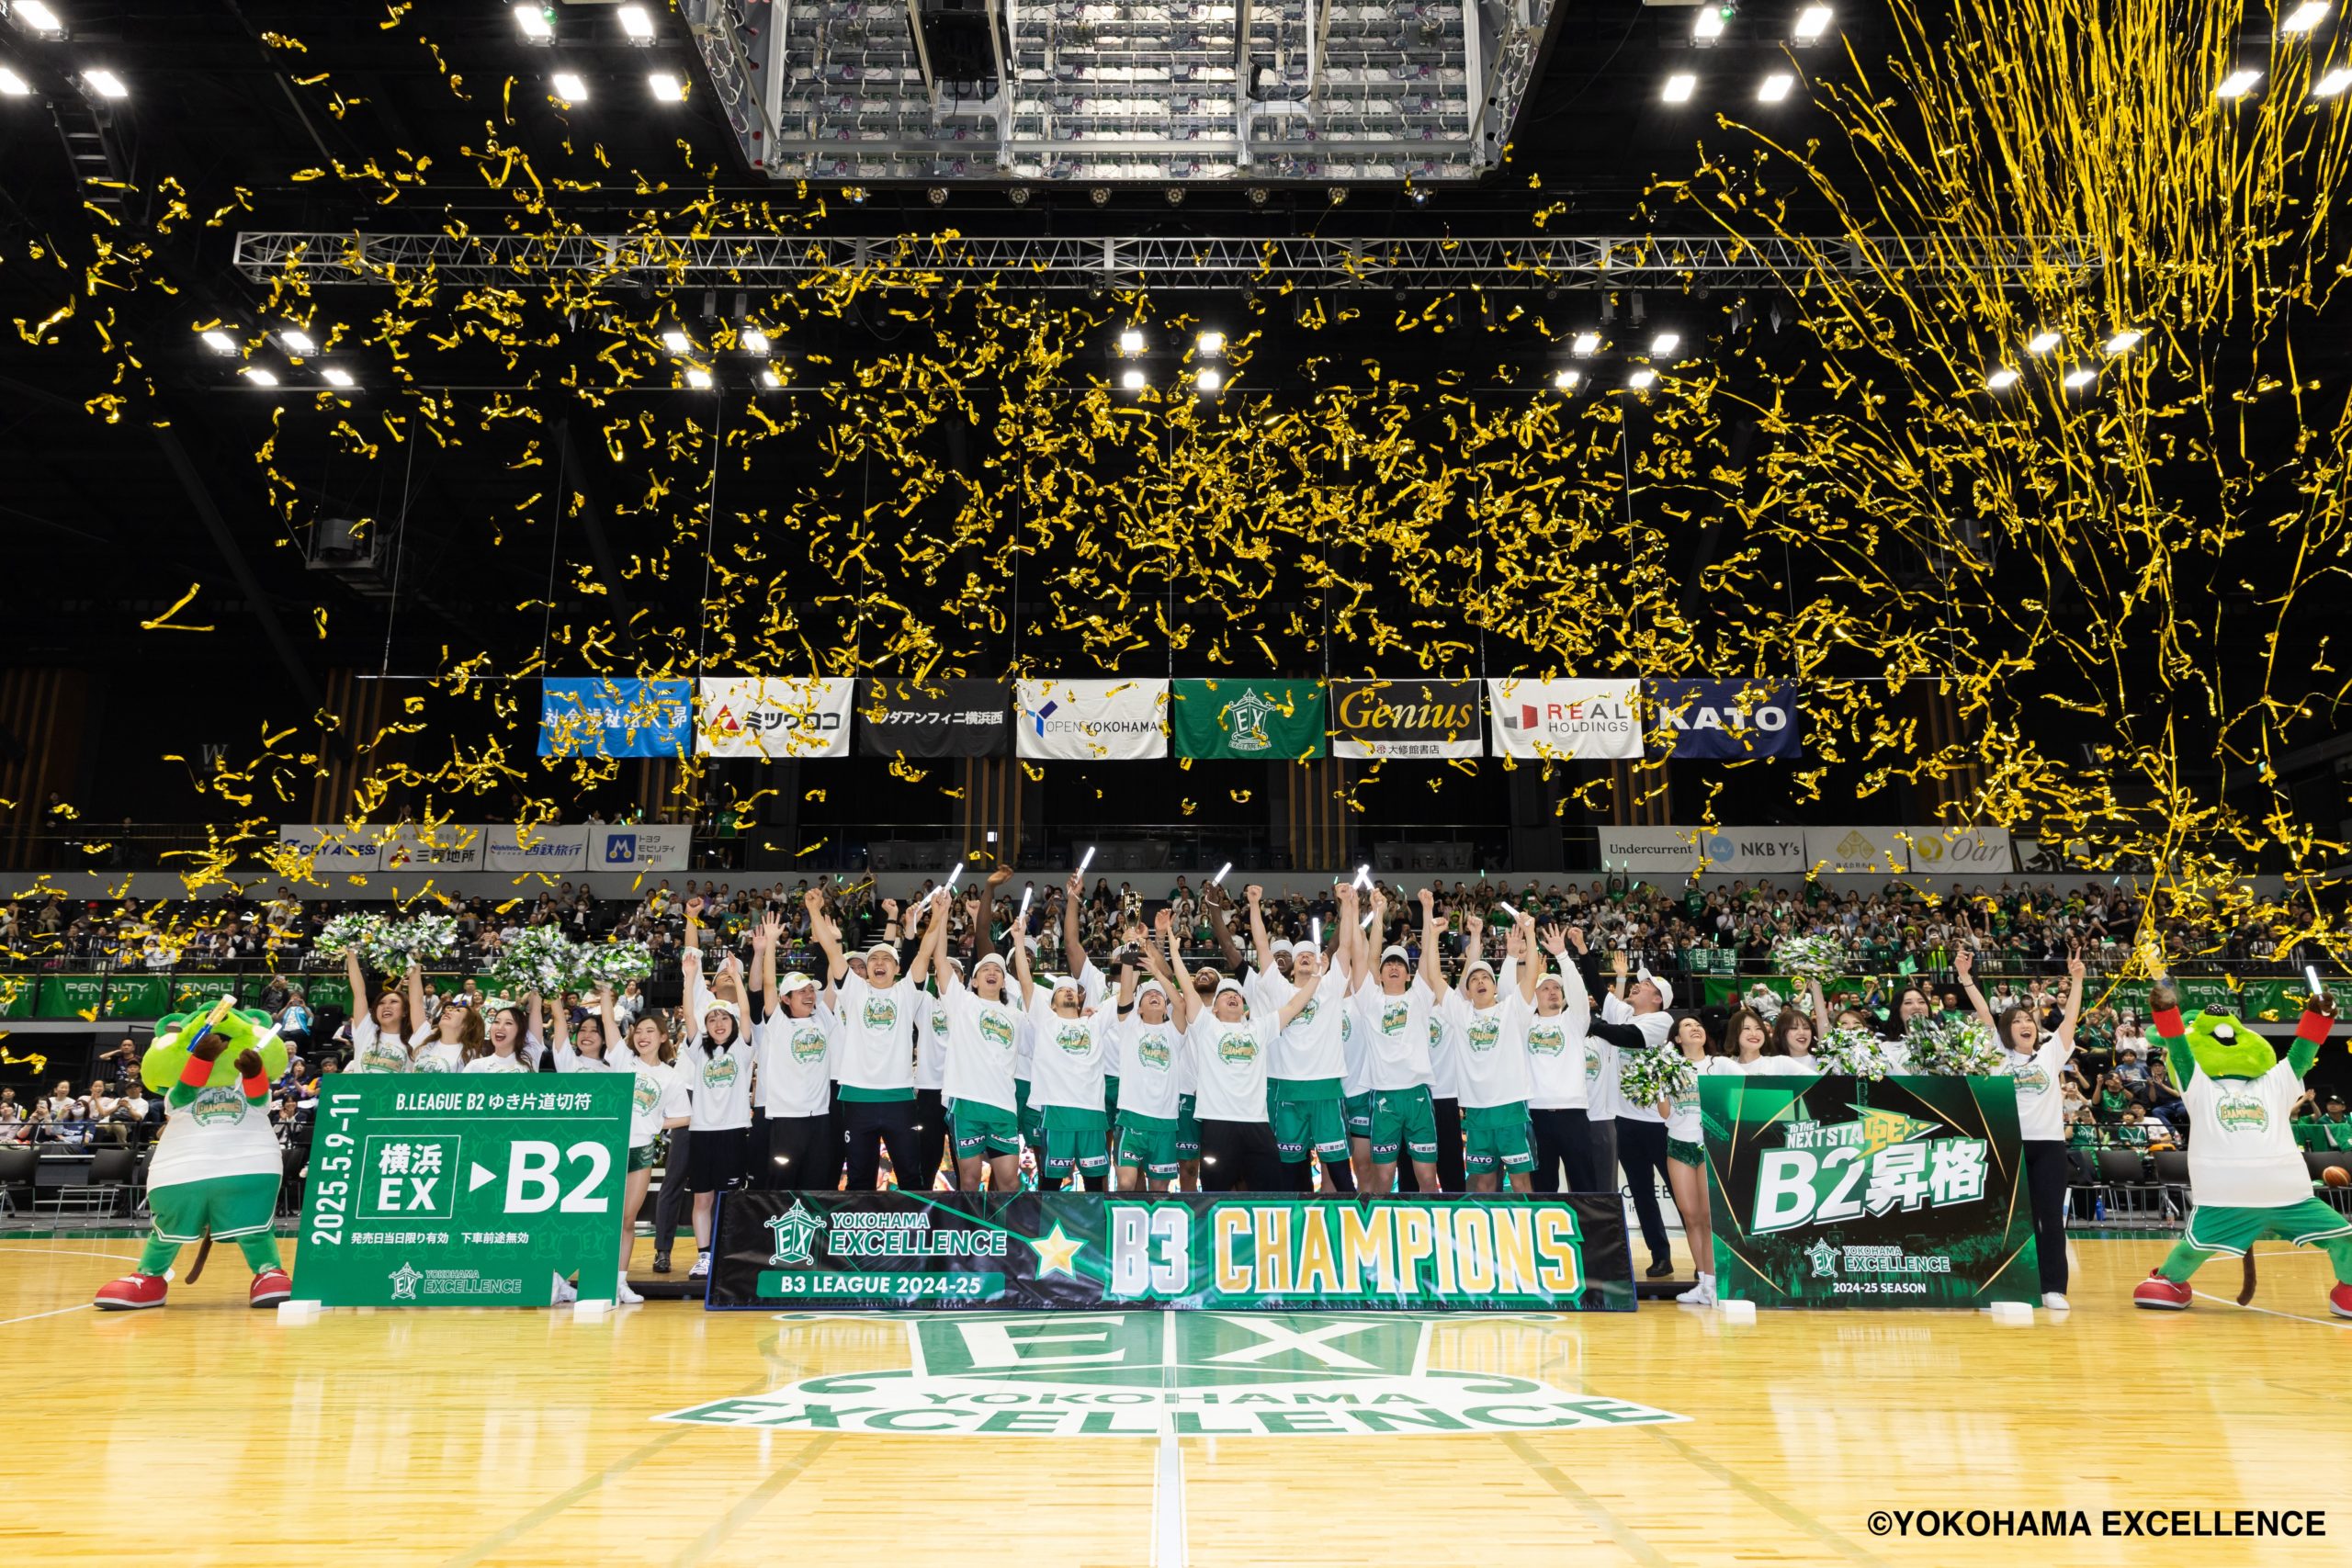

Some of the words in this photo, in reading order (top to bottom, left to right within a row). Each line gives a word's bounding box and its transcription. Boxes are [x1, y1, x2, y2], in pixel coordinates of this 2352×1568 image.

[1340, 689, 1473, 728] Genius
[1547, 703, 1628, 720] REAL
[545, 707, 662, 728] 社会福祉法
[866, 711, 1003, 725] ツダアンフィニ横浜西
[1659, 705, 1786, 732] KATO
[1046, 721, 1081, 733] OPEN
[1086, 721, 1158, 733] YOKOHAMA
[1548, 721, 1629, 733] HOLDINGS
[1388, 744, 1440, 755] 大修館書店
[639, 835, 661, 843] トヨタ
[525, 843, 582, 856] 西鉄旅行
[639, 844, 675, 852] モビリティ
[1610, 843, 1693, 854] Undercurrent
[1741, 842, 1775, 857] NKB
[1951, 837, 2004, 863] Oar
[416, 850, 475, 863] 三菱地所
[65, 982, 149, 993] PENALTY
[287, 983, 347, 994] ENALTY
[396, 1093, 462, 1111] B.LEAGUE
[467, 1093, 485, 1111] B2
[489, 1092, 593, 1111] ゆき片道切符
[1799, 1122, 1815, 1132] THE
[1787, 1129, 1826, 1149] NEXT
[1374, 1144, 1397, 1153] KATO
[379, 1143, 442, 1176] 横浜
[1466, 1155, 1493, 1163] KATO
[503, 1140, 611, 1213] B2
[377, 1178, 436, 1211] EX
[831, 1212, 930, 1229] YOKOHAMA
[351, 1232, 448, 1244] 発売日当日限り有効
[461, 1232, 529, 1244] 下車前途無効
[778, 1225, 814, 1257] EX
[828, 1229, 1007, 1257] EXCELLENCE
[1111, 1206, 1191, 1295] B3
[1214, 1206, 1578, 1295] CHAMPIONS
[1842, 1245, 1903, 1257] YOKOHAMA
[1844, 1256, 1951, 1272] EXCELLENCE
[425, 1269, 480, 1279] YOKOHAMA
[424, 1279, 522, 1294] EXCELLENCE
[781, 1277, 806, 1293] B3
[812, 1278, 892, 1294] LEAGUE
[897, 1278, 980, 1294] 2024-25
[1833, 1282, 1878, 1293] 2024-25
[1881, 1282, 1927, 1293] SEASON
[921, 1393, 1430, 1405] YOKOHAMA
[664, 1399, 1679, 1434] EXCELLENCE
